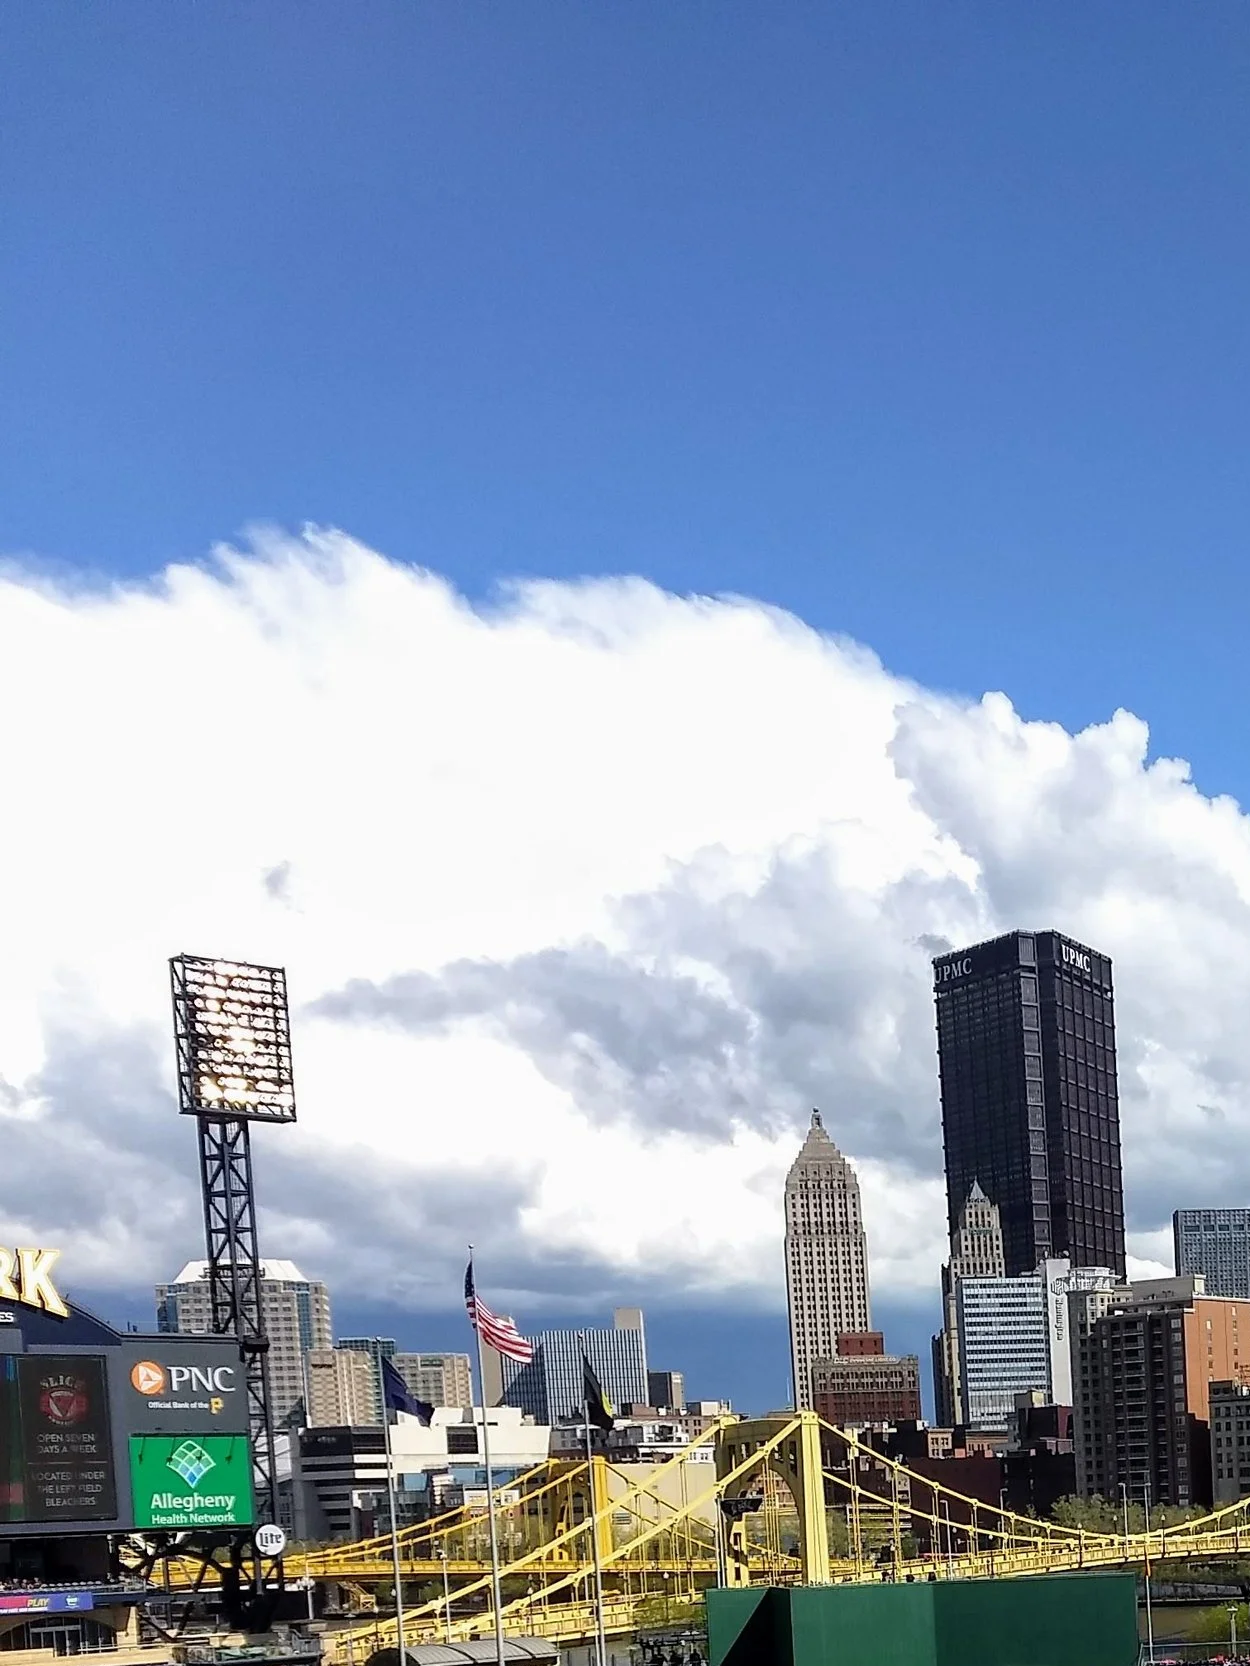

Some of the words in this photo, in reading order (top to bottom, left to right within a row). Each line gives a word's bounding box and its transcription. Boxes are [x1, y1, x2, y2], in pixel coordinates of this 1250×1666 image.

[1062, 944, 1091, 973] UPMC
[934, 958, 972, 984] UPMC
[166, 1366, 236, 1392] PNC
[148, 1401, 172, 1409] Official
[173, 1401, 189, 1409] Bank
[190, 1401, 197, 1409] of
[198, 1401, 209, 1409] the
[37, 1433, 63, 1443] OPEN
[150, 1492, 236, 1512] Allegheny
[151, 1514, 188, 1525] Health
[189, 1512, 236, 1524] Network
[259, 1532, 282, 1547] Lite
[27, 1597, 50, 1608] PLAY
